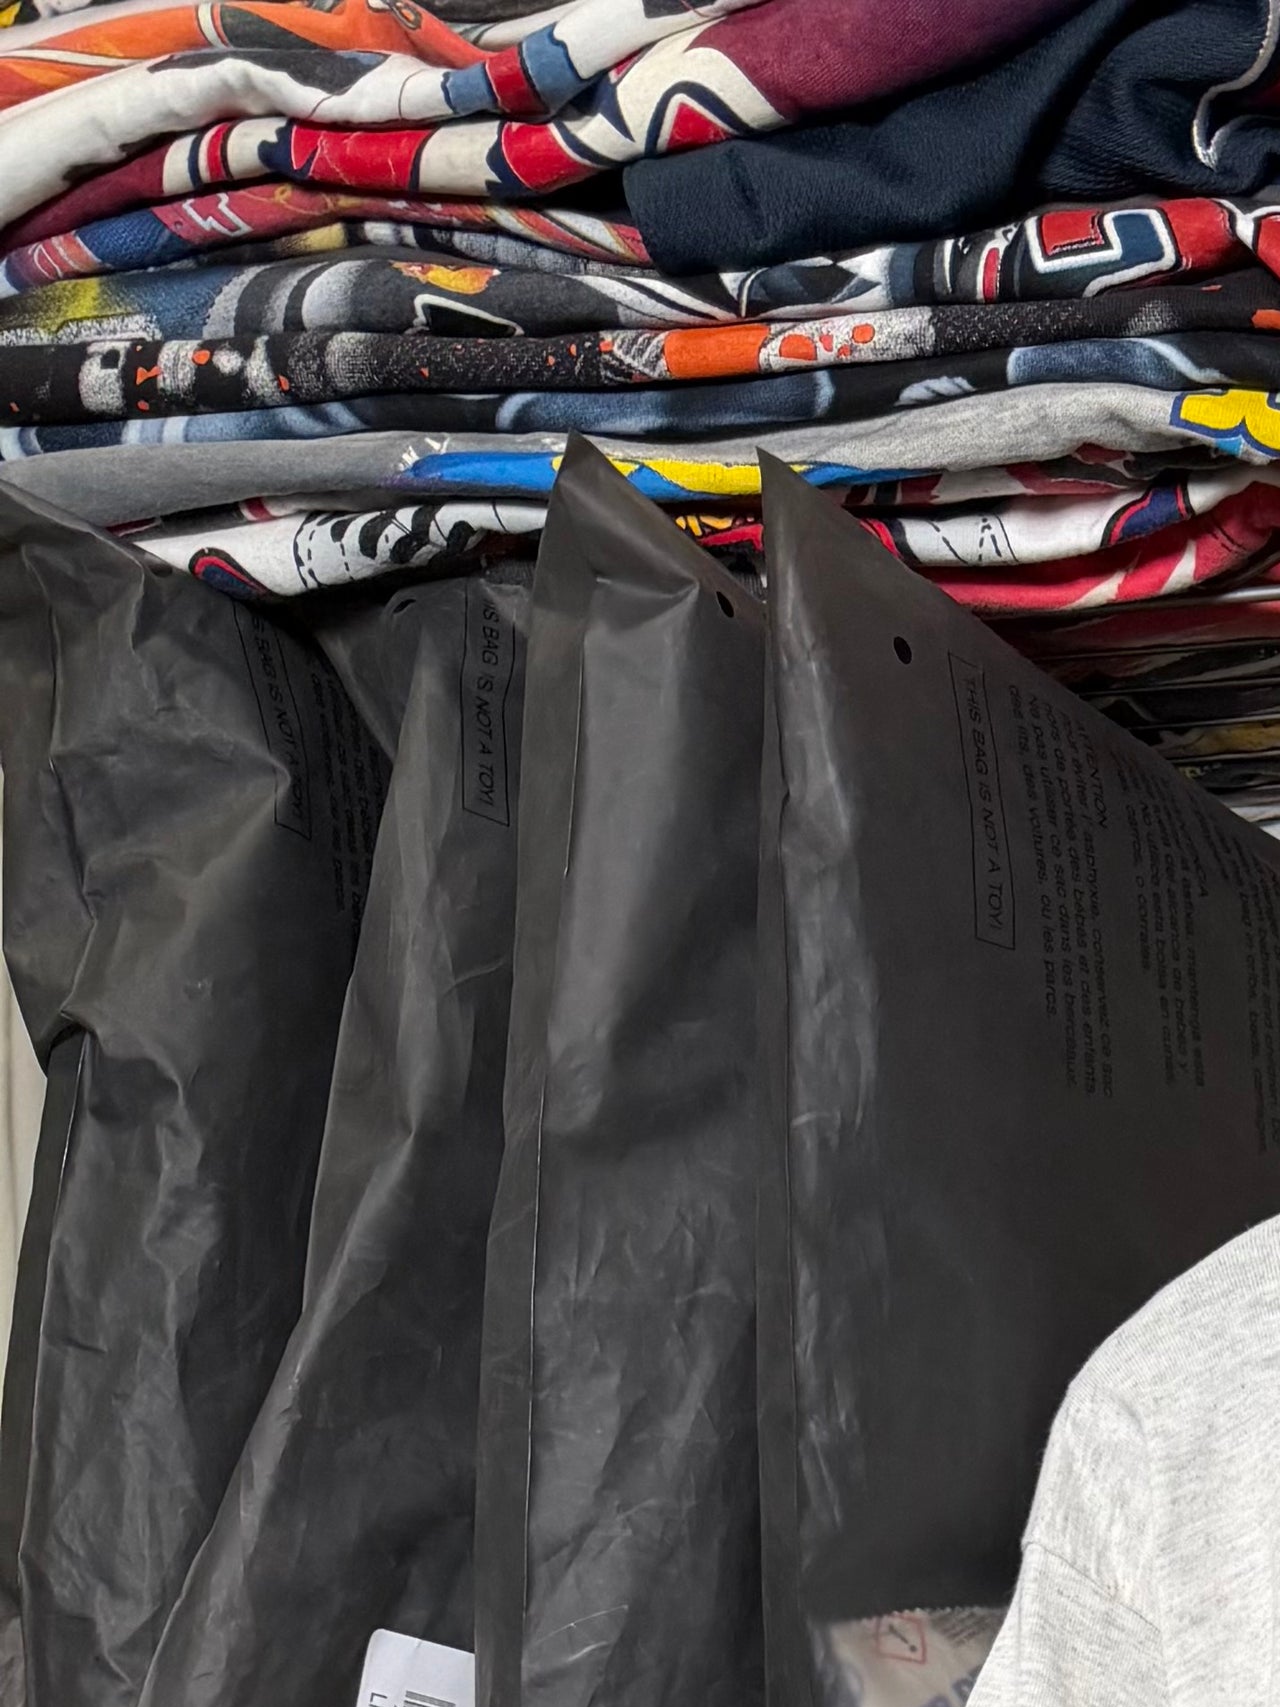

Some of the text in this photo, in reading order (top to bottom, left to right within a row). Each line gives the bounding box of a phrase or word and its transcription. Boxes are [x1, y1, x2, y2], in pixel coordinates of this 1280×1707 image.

[476, 696, 493, 739] NOT
[972, 728, 988, 775] BAG
[979, 786, 991, 802] IS
[981, 808, 999, 856] NOT
